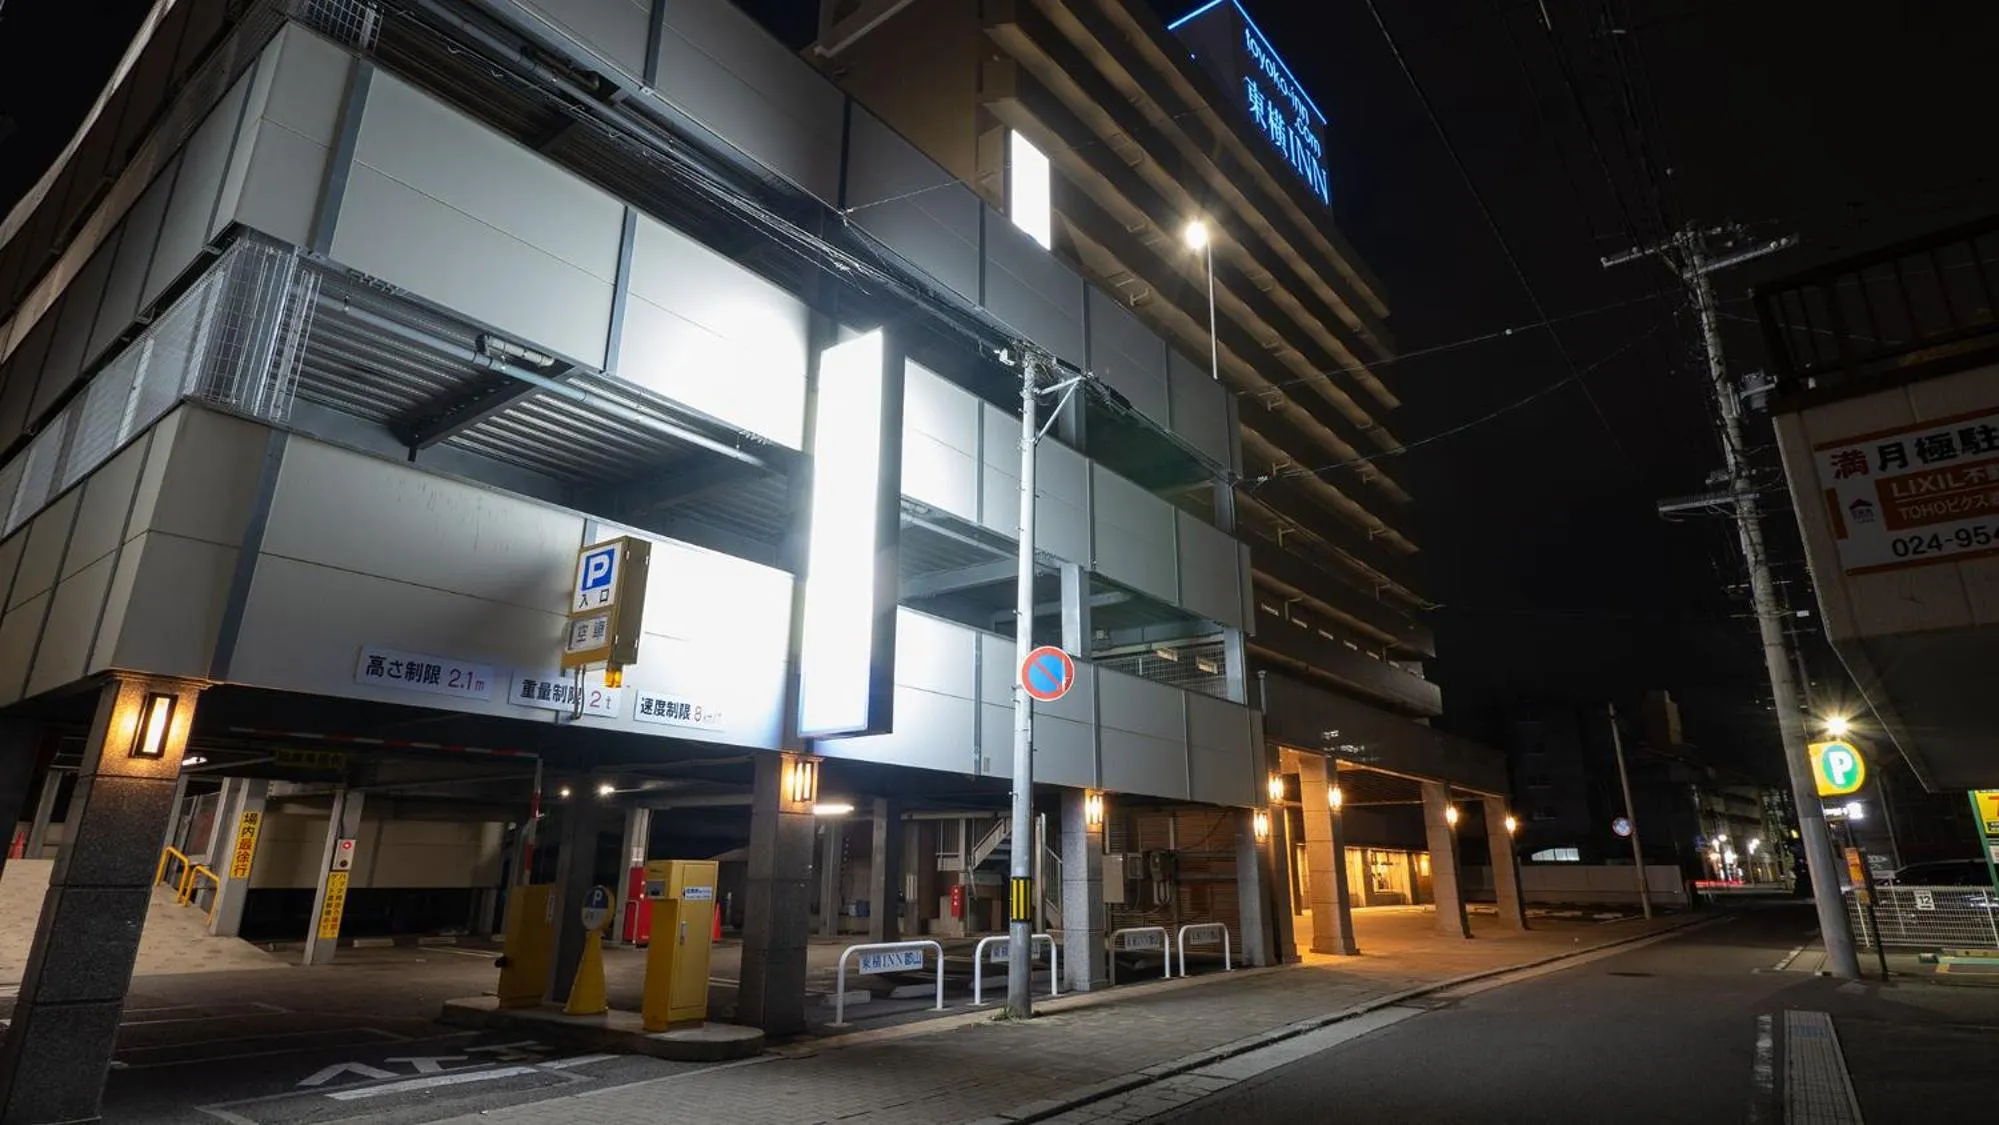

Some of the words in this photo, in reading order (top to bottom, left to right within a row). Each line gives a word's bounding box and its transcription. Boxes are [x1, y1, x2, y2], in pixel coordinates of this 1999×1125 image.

[1244, 28, 1309, 128] toyoko-inn
[1243, 76, 1330, 205] 東横INN
[586, 554, 610, 588] P
[579, 588, 610, 609] 入口
[366, 655, 441, 685] 高さ制限
[448, 668, 485, 691] 2.1m
[520, 679, 582, 705] 重量制限
[640, 697, 691, 720] 速度制限
[1827, 751, 1854, 785] P
[234, 812, 258, 877] 場内最徐行
[592, 889, 603, 908] P
[862, 952, 921, 970] 東横INN郡山
